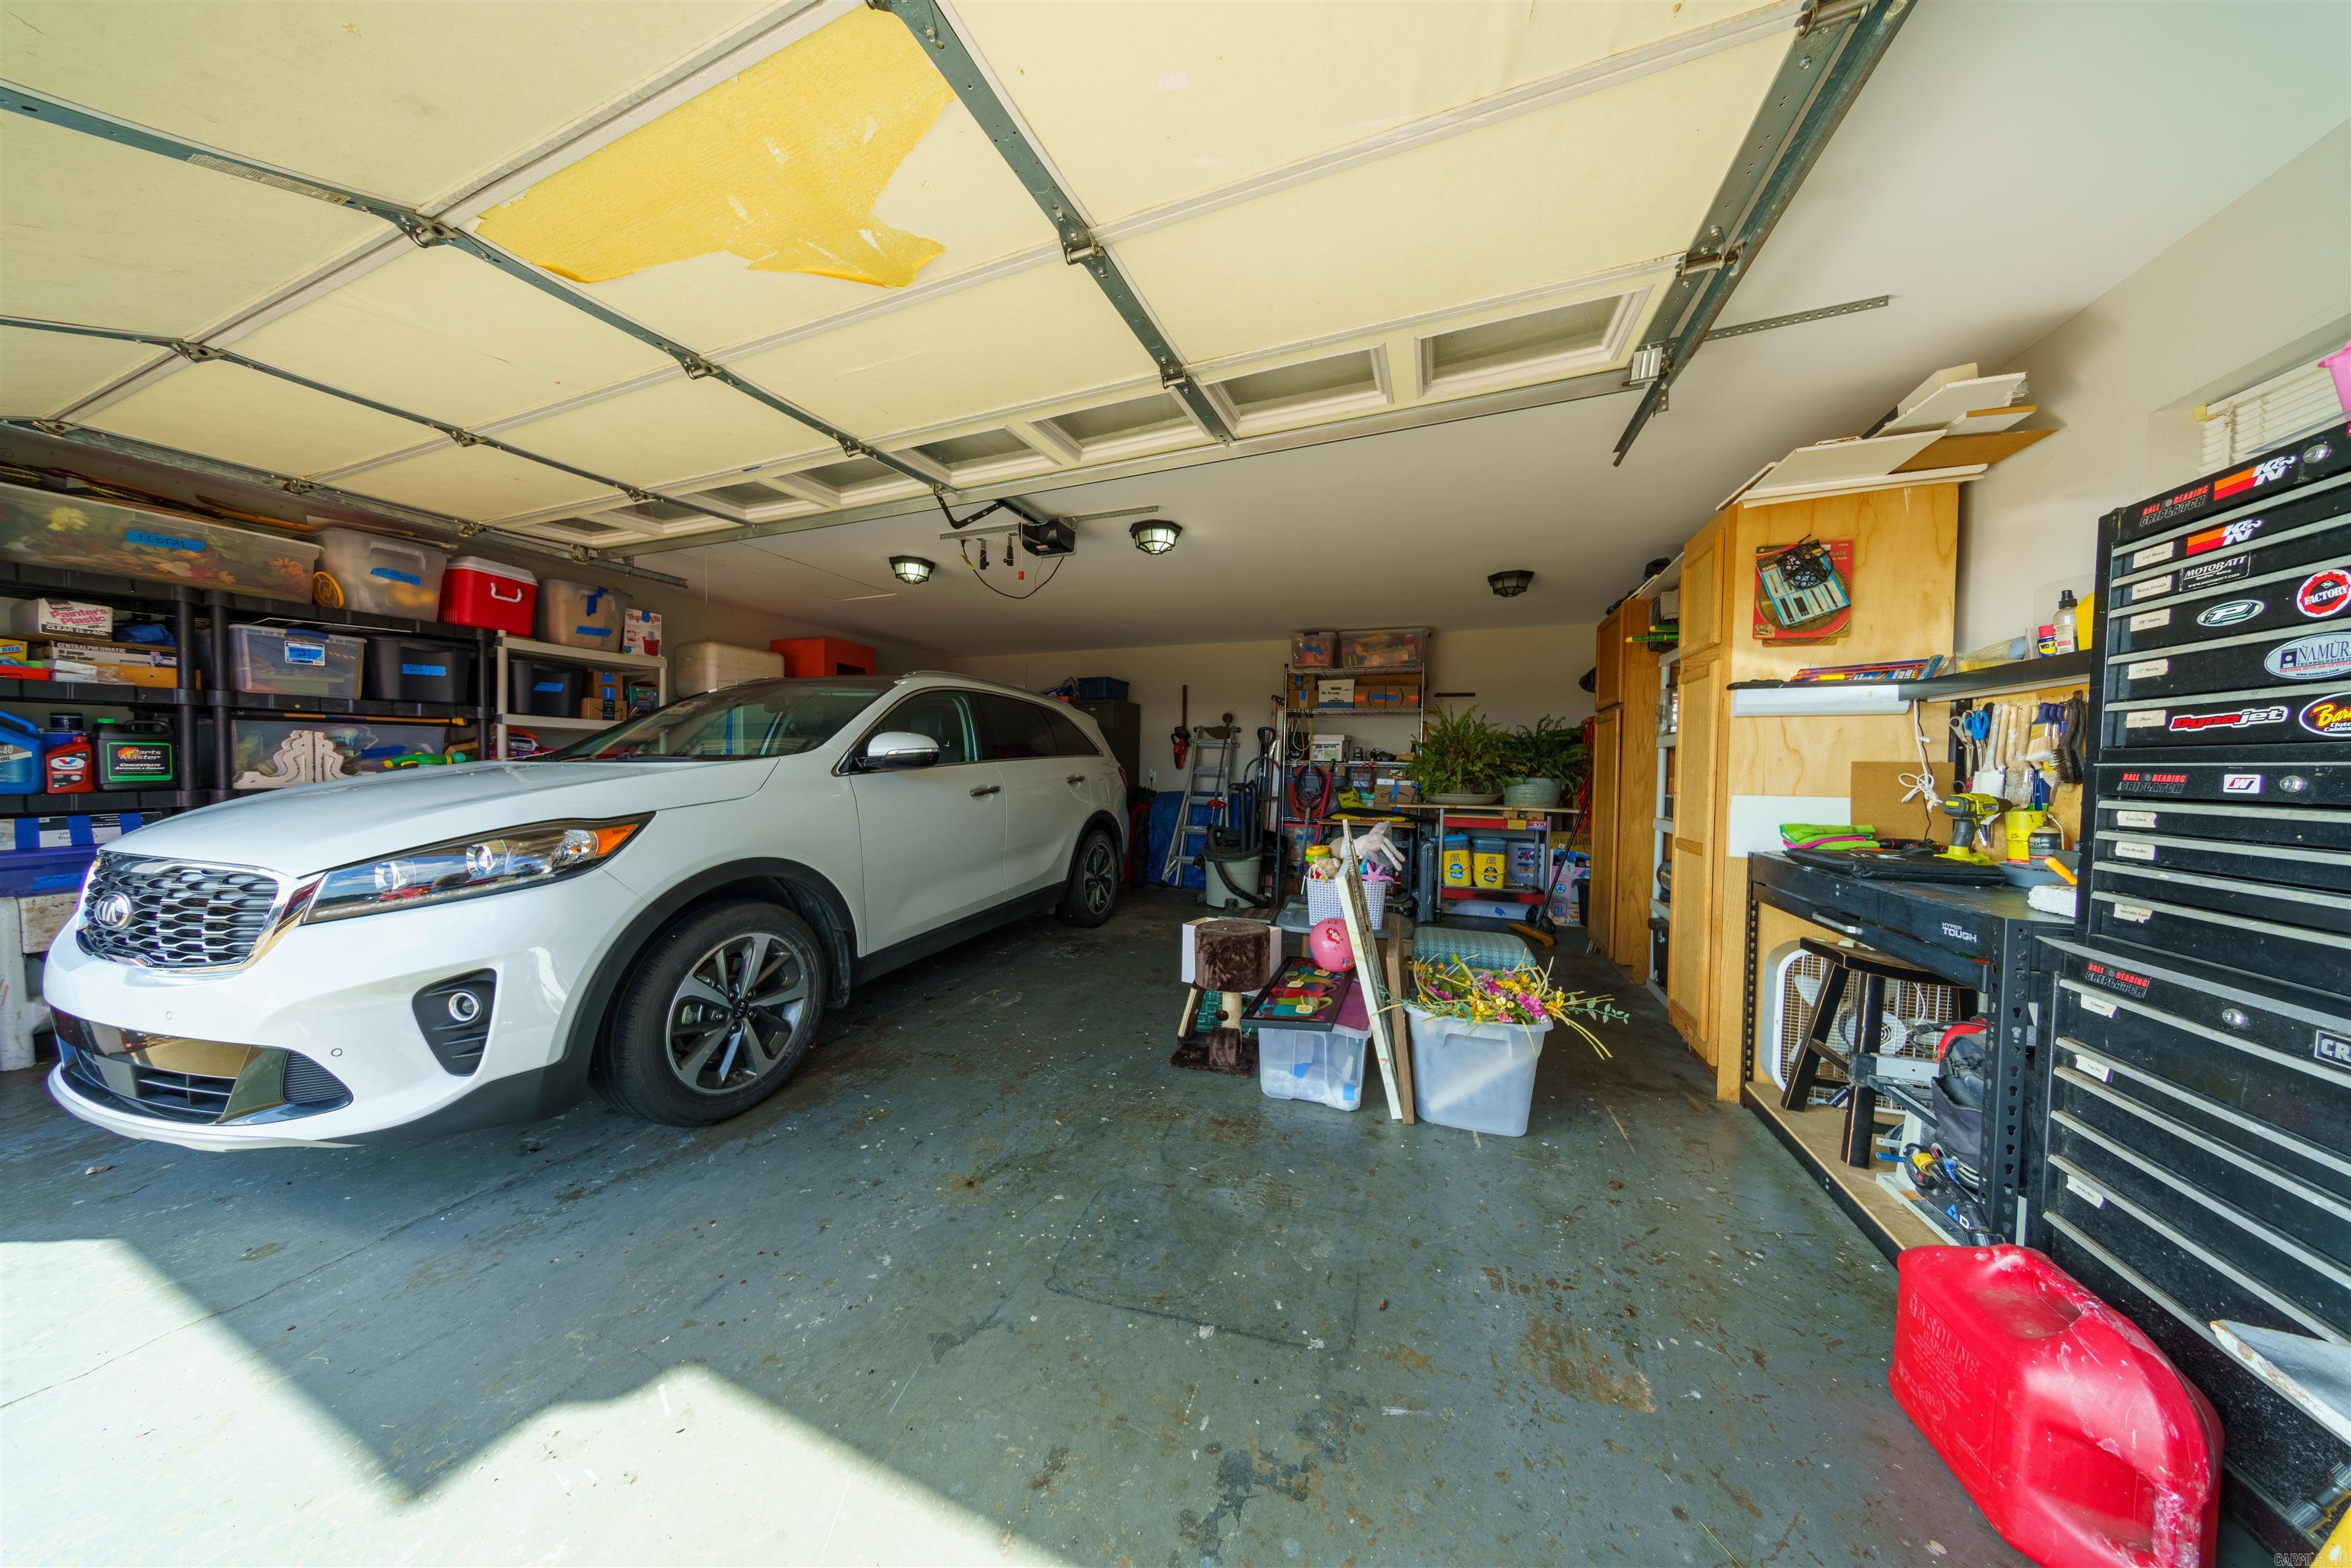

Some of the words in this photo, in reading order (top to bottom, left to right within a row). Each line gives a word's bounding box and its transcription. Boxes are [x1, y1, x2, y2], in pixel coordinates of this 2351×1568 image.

[2143, 503, 2160, 516] BALL
[2173, 484, 2209, 505] BEARING
[2140, 495, 2206, 527] GRIPLATCH
[2184, 556, 2248, 578] MOTOBATT
[2304, 585, 2349, 605] FACTORY
[49, 608, 109, 618] Painter's
[60, 615, 106, 624] Plastic
[47, 624, 73, 633] CLEAR
[2297, 640, 2351, 663] NAMUR
[2297, 657, 2344, 667] TECHNOLOGIES
[2172, 708, 2286, 729] Dynojet
[2118, 781, 2183, 794] GRIPLATCH
[2122, 773, 2140, 781] BALL
[2152, 774, 2187, 783] BEARING
[1942, 922, 1962, 931] HYPER
[1942, 926, 1978, 943] TOUGH
[2085, 970, 2145, 996] GRIPLATCH
[2088, 963, 2105, 974] BALL
[2115, 971, 2148, 987] BEARING
[1909, 1293, 1980, 1381] GASOLINE
